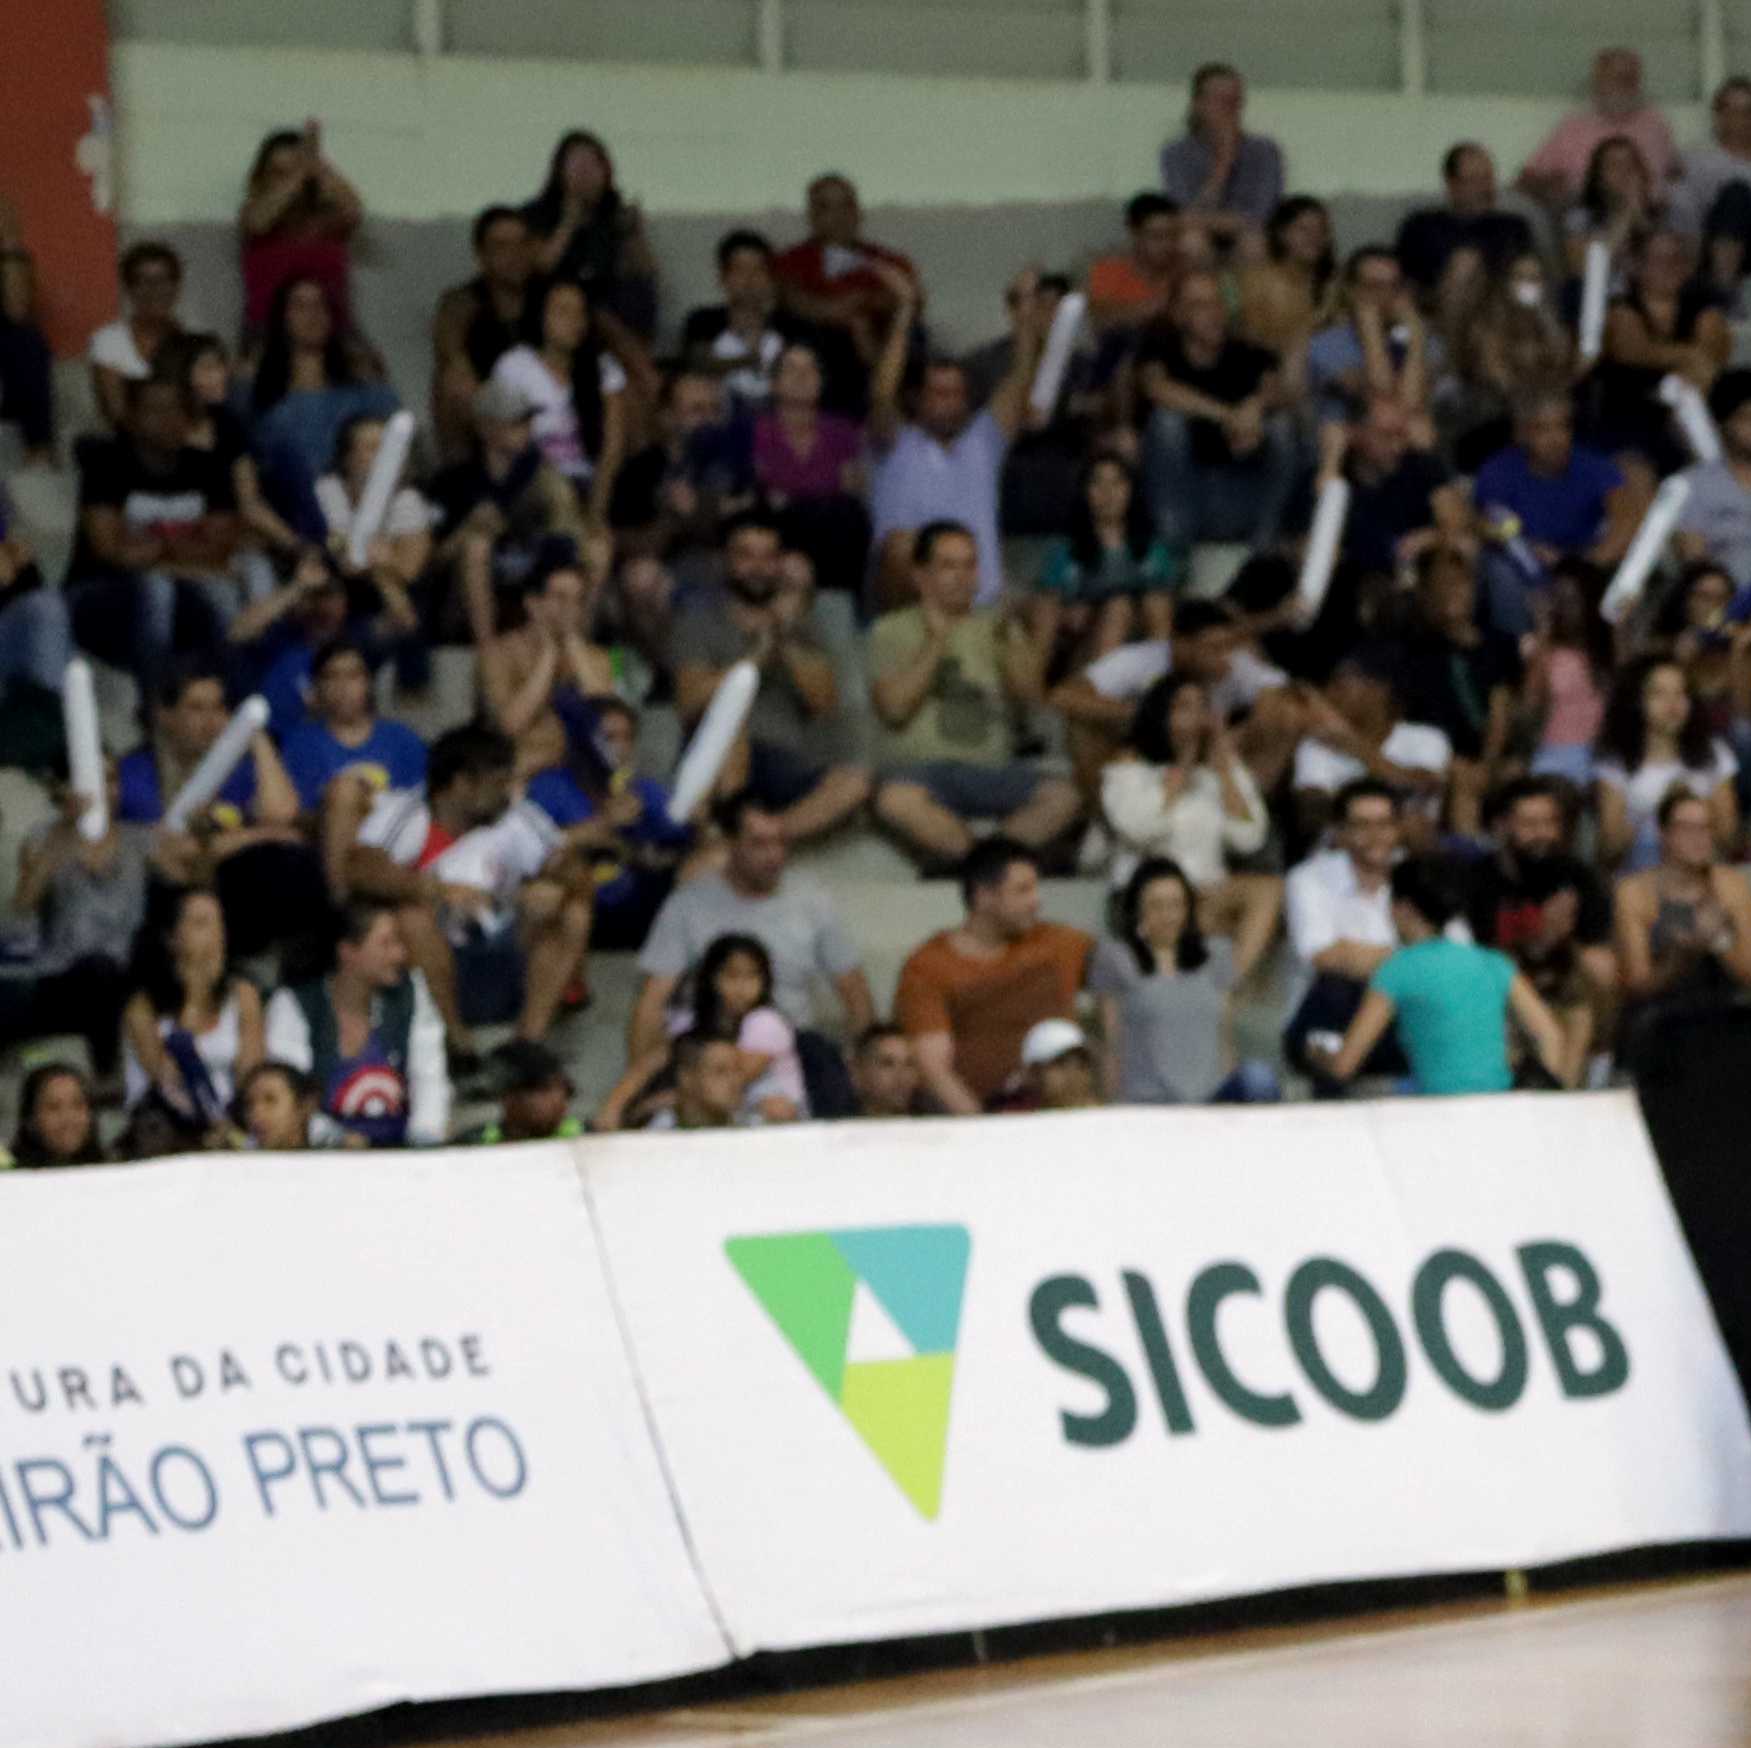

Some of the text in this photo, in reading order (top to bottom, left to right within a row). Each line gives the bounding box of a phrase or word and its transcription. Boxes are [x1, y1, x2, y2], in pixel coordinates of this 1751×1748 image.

[9, 1333, 491, 1413] URA DA CIDADE
[1028, 1241, 1630, 1450] SICOOB
[0, 1415, 528, 1550] IRÃO PRETO
